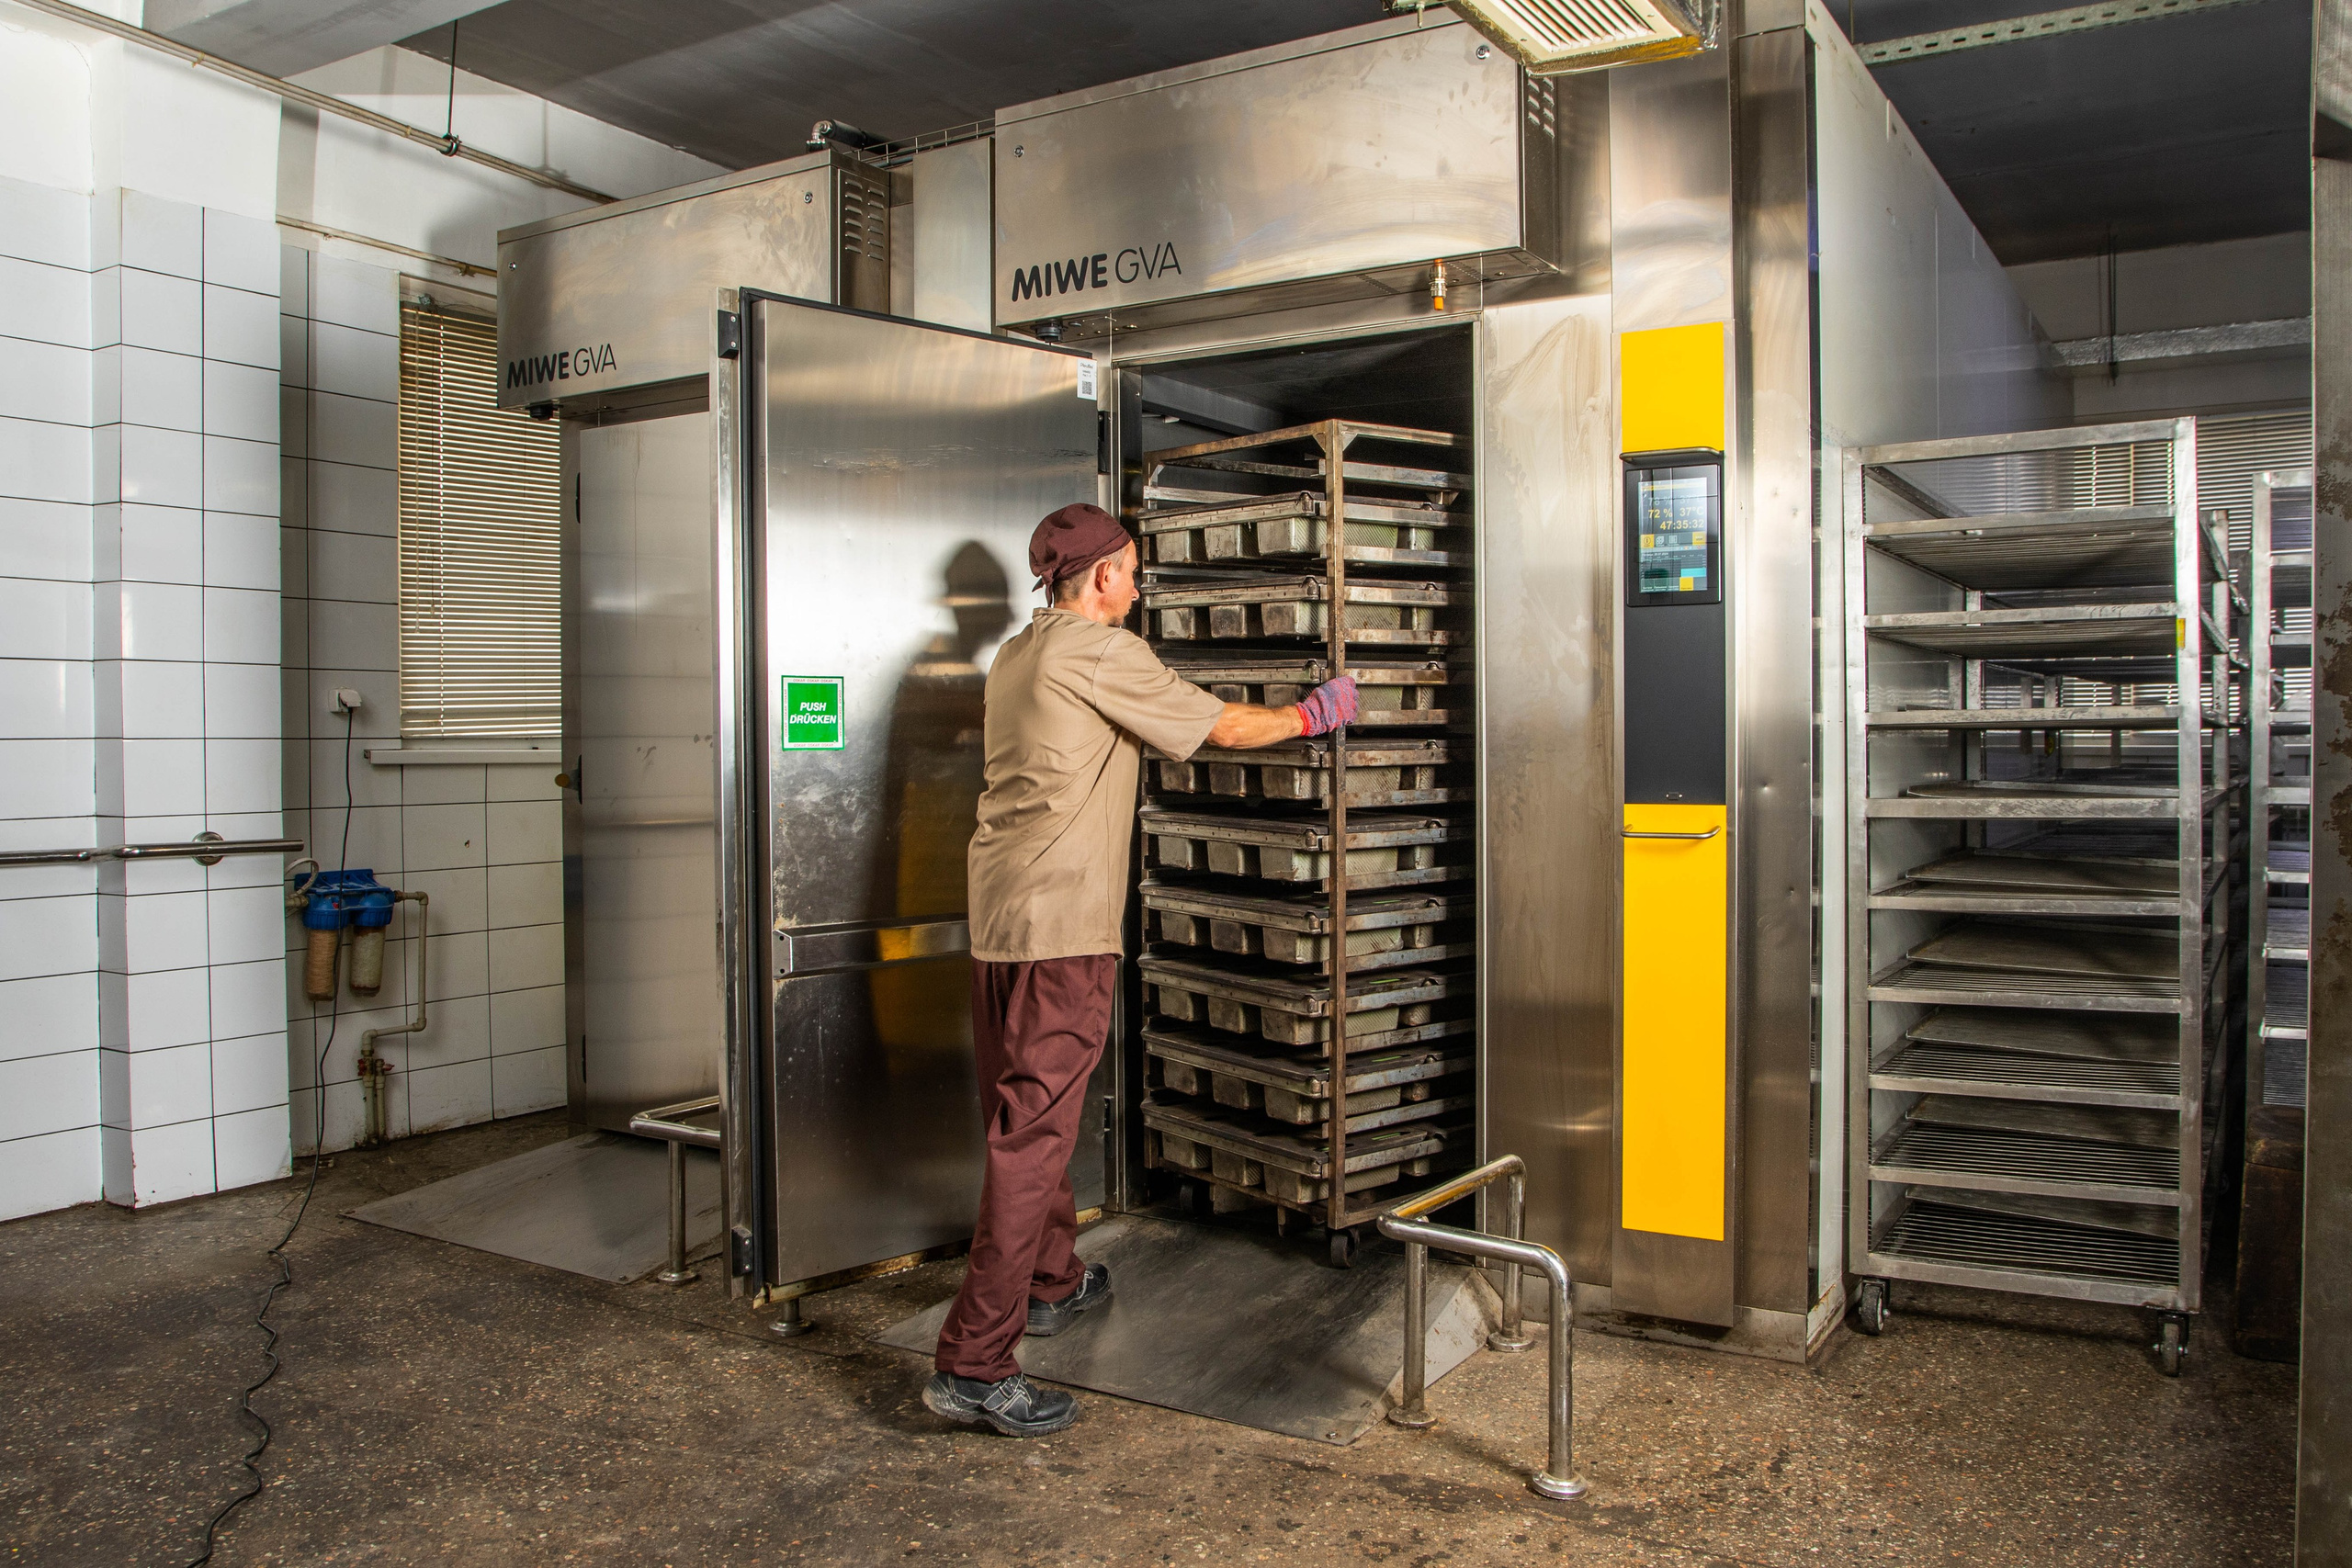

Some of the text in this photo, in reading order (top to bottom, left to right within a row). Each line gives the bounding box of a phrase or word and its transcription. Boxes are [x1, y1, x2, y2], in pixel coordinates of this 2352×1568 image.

[1012, 242, 1182, 302] MIWE GVA
[507, 343, 616, 389] MIWE GVA
[1648, 506, 1704, 519] 72 % 37°C
[1660, 519, 1704, 530] 47:35:32
[800, 702, 827, 711] PUSH
[790, 713, 836, 724] DRÜCKEN
